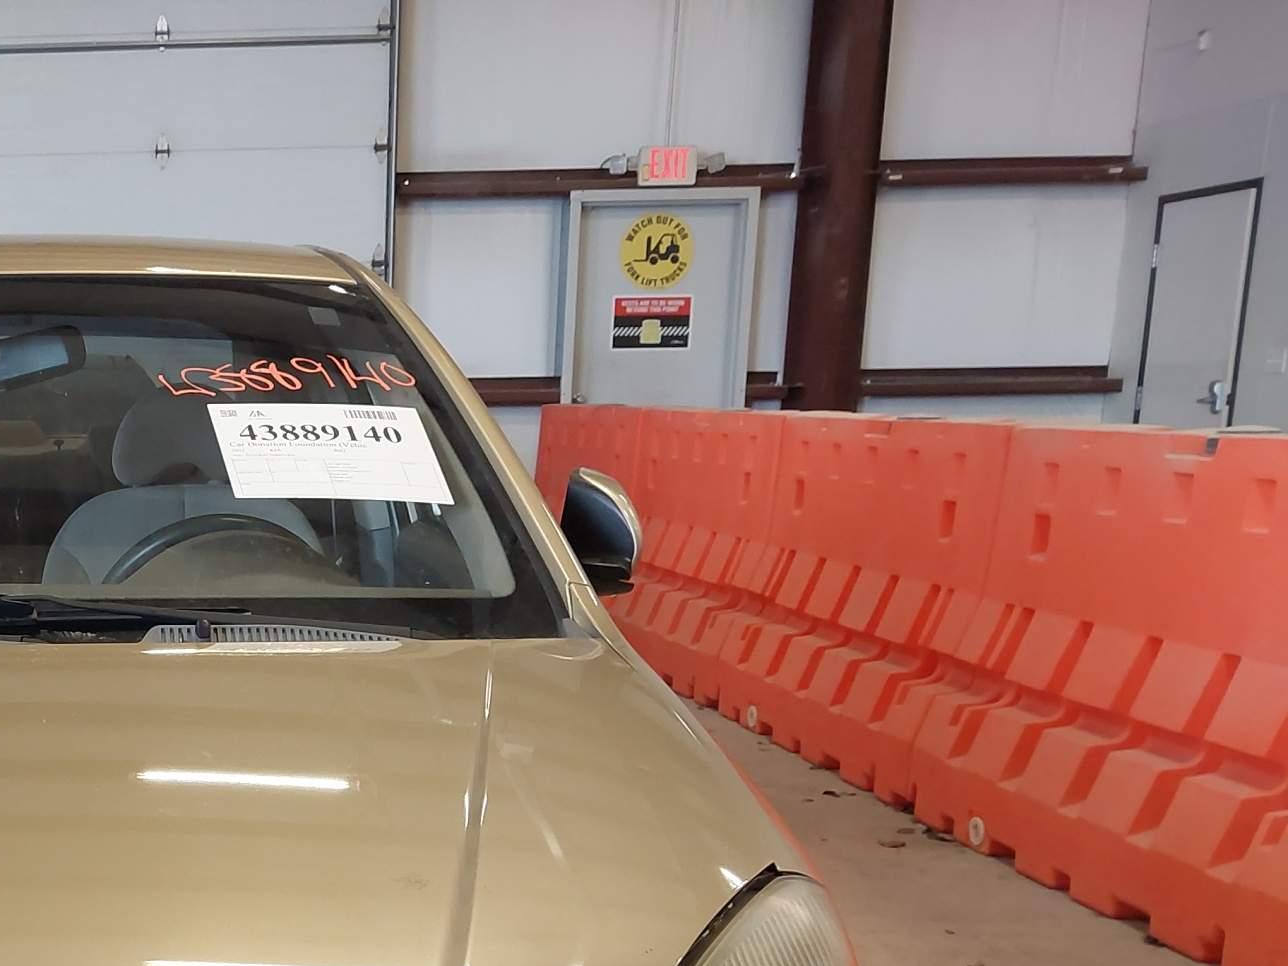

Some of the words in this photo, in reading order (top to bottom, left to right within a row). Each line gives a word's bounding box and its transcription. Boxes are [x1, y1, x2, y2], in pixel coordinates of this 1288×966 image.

[649, 148, 688, 178] EXIT
[625, 216, 653, 242] WATCH
[656, 216, 674, 226] OUT
[674, 222, 689, 240] FOR
[624, 261, 640, 280] FORK
[641, 277, 658, 287] LIFT
[660, 261, 687, 285] TRUCKS
[239, 424, 402, 443] 43889140
